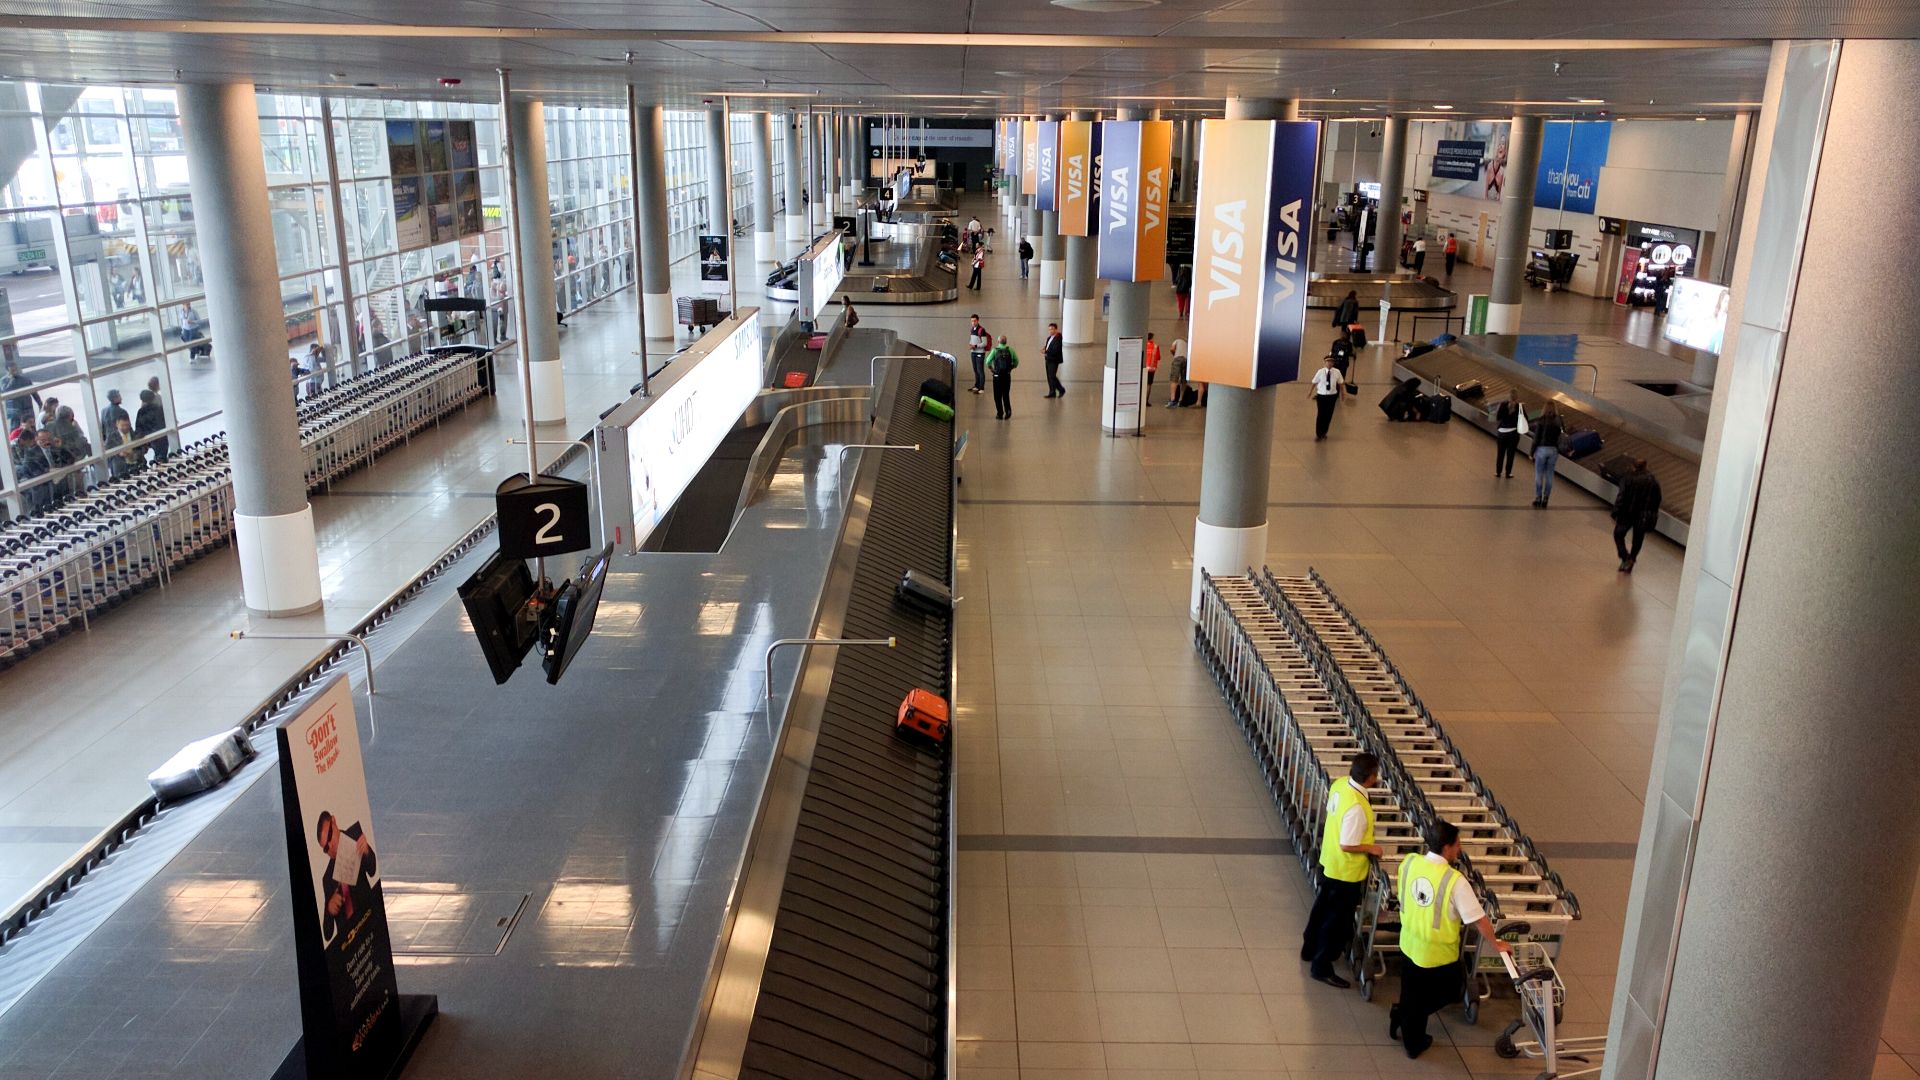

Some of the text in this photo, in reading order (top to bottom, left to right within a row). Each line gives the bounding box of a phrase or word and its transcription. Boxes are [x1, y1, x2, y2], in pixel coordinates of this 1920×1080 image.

[1027, 143, 1036, 173] VISA
[1041, 147, 1052, 184] VISA
[1068, 154, 1083, 203] VISA
[1577, 181, 1591, 199] citi
[884, 190, 890, 199] 4
[1109, 166, 1129, 235] VISA
[1144, 166, 1163, 235] VISA
[1353, 194, 1359, 204] 3
[842, 220, 851, 234] 2
[1546, 233, 1551, 246] 1
[1561, 234, 1568, 247] 1
[1208, 199, 1247, 311] VISA
[1273, 198, 1302, 313] VISA
[533, 502, 564, 545] 2
[310, 713, 337, 751] Don't
[313, 734, 338, 763] Swallow
[315, 763, 327, 775] The
